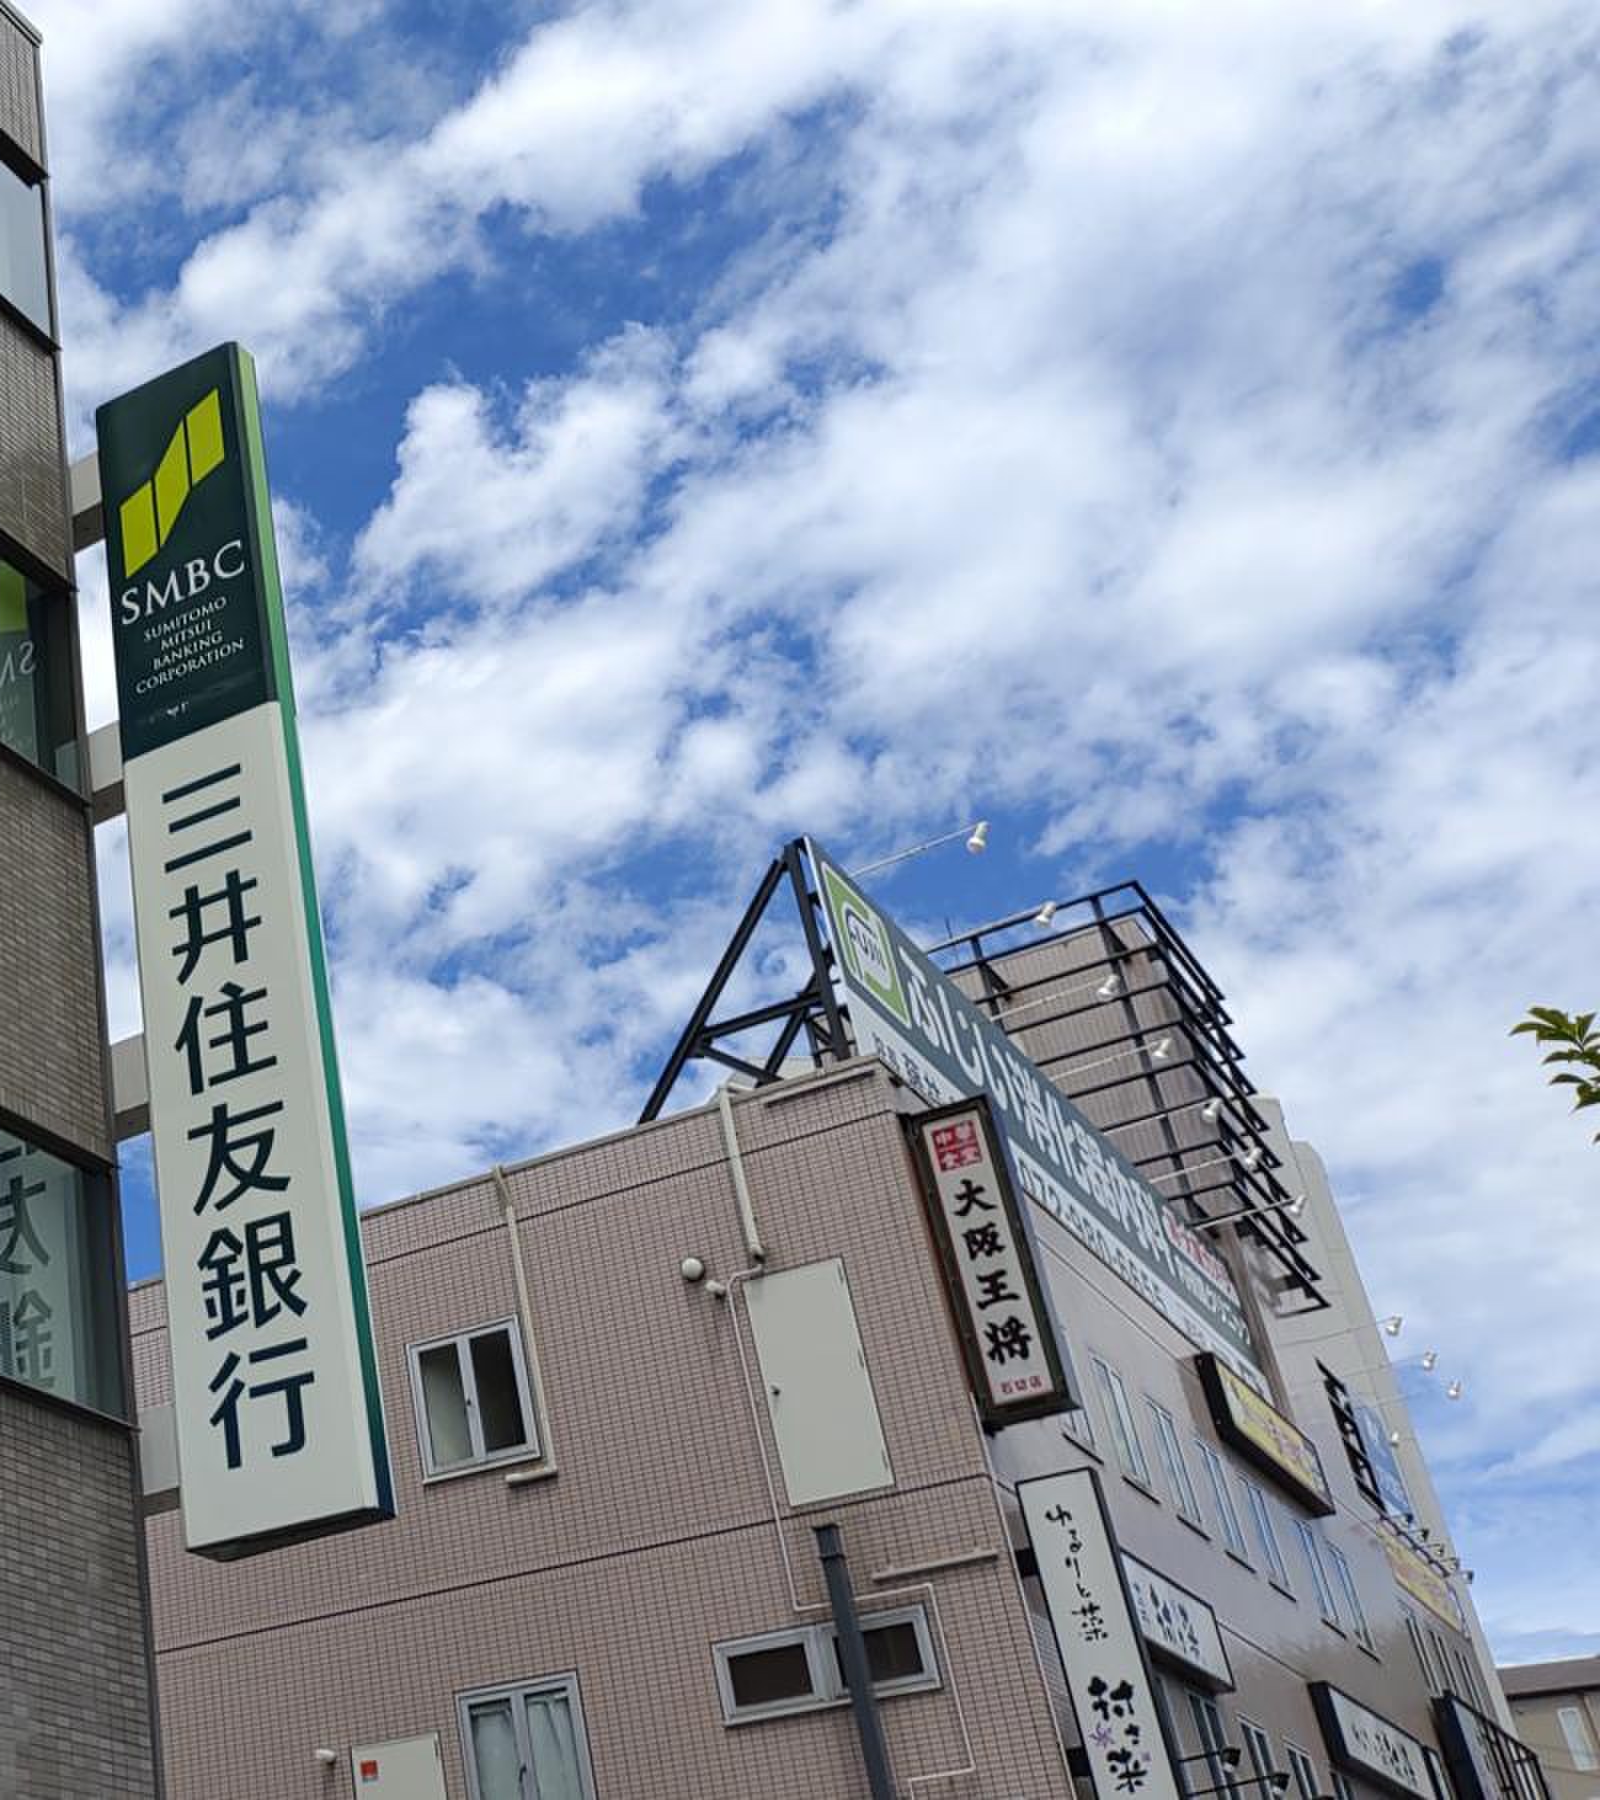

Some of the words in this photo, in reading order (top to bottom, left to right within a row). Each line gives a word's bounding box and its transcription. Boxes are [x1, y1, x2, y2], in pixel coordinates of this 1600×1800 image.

[119, 540, 245, 625] SMBC
[143, 596, 227, 642] SUMITOMO
[160, 619, 212, 651] MITSUI
[135, 637, 245, 694] CORPORATION
[152, 630, 223, 671] BANKING
[162, 763, 315, 1470] 三井住友銀行
[954, 1178, 1032, 1365] 大阪王将
